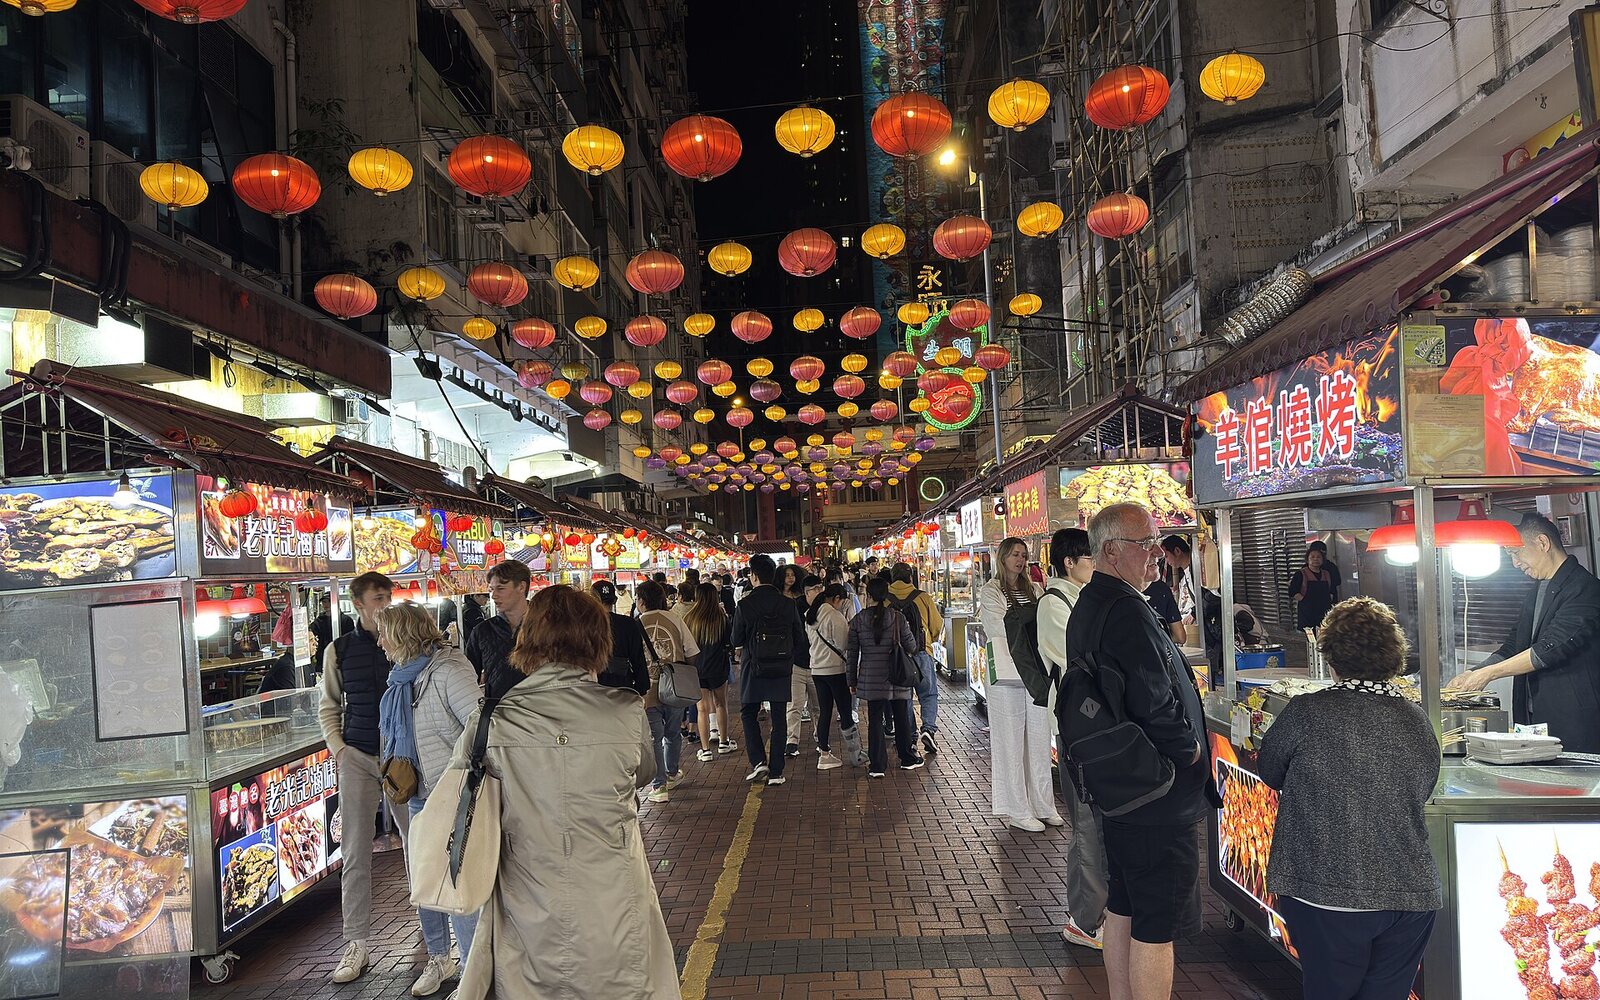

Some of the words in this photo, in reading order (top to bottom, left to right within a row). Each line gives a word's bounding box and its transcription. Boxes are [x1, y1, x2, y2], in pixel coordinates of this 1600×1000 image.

[1215, 369, 1357, 481] 羊倌燒烤
[265, 756, 338, 818] 老光記滷味
